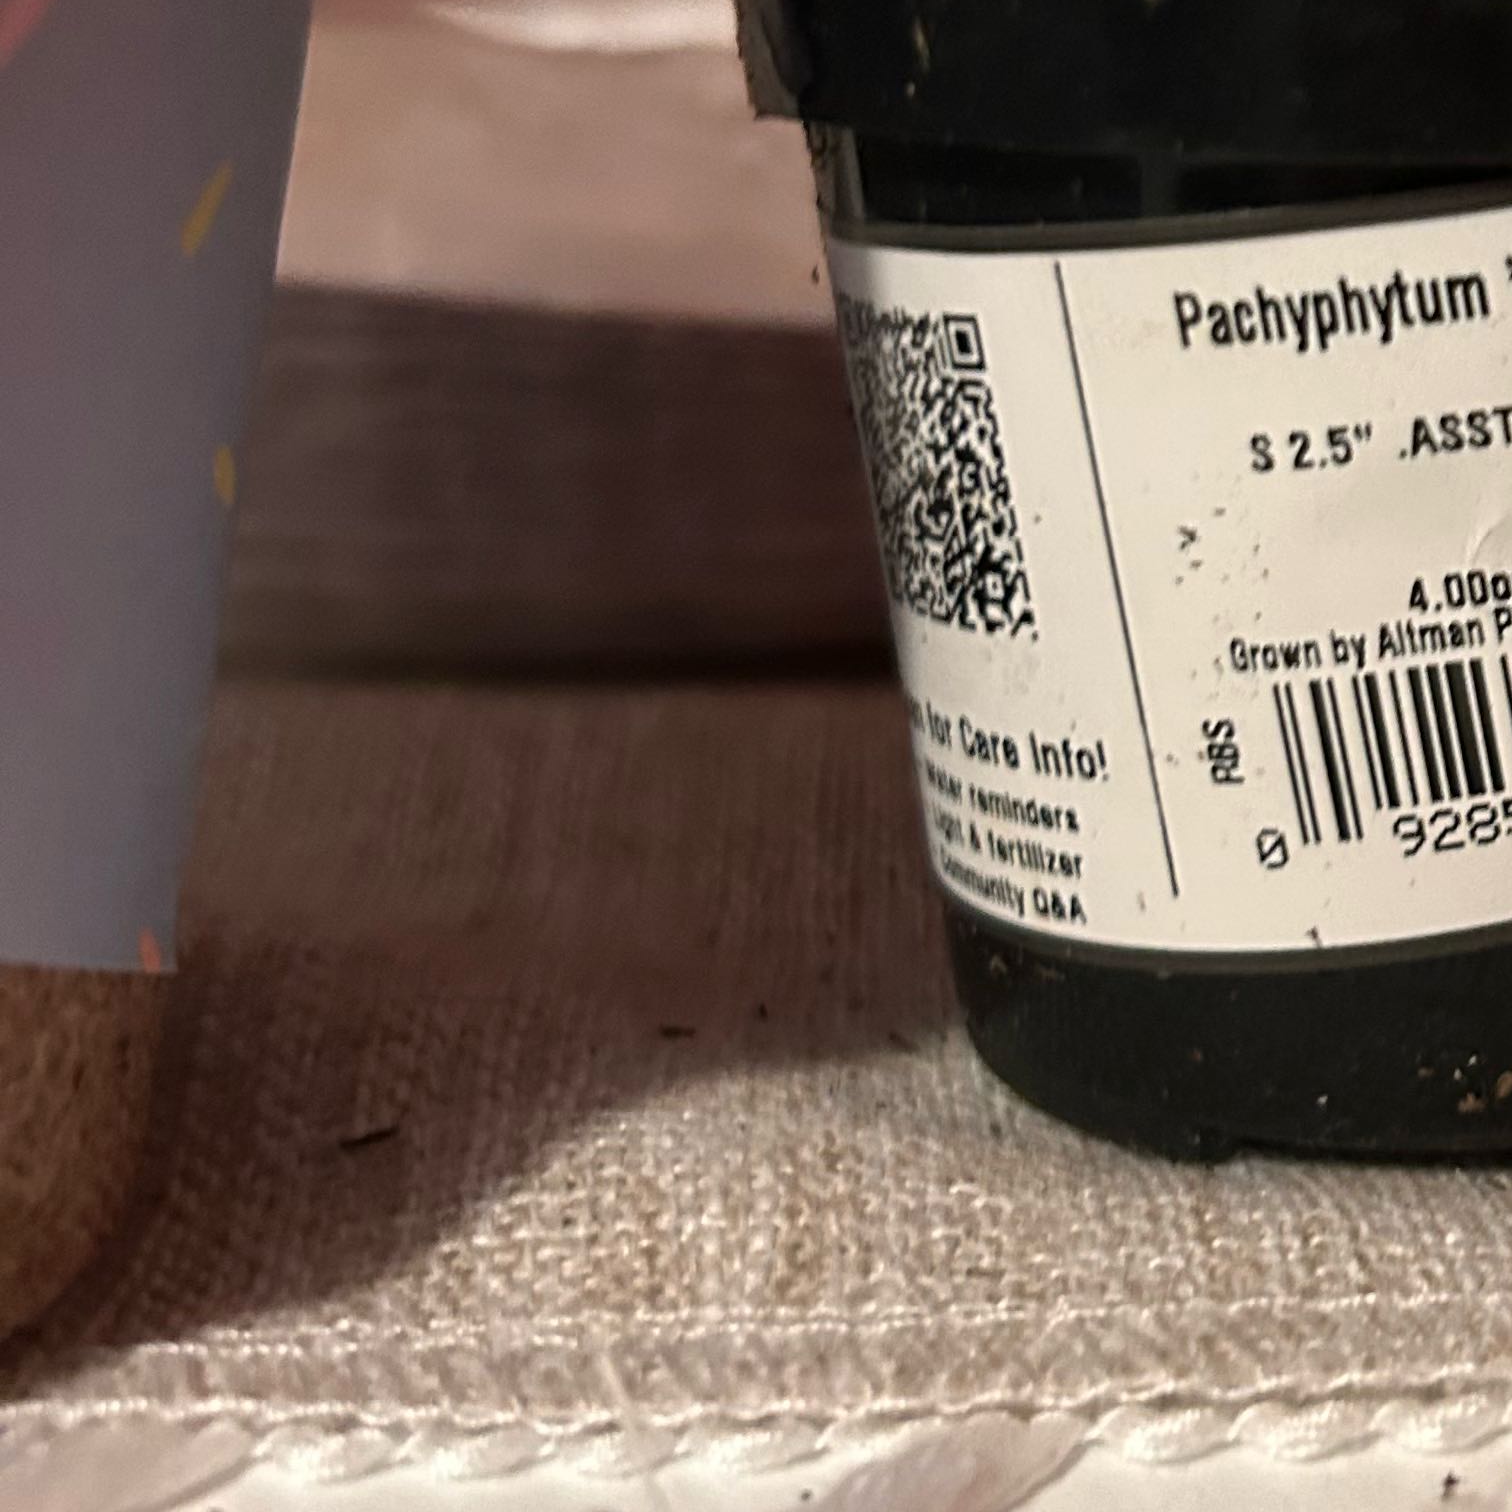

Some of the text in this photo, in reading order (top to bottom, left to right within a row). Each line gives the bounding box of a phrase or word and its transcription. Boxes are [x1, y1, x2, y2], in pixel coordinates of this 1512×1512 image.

[1173, 270, 1490, 353] Pachyphytum
[1249, 432, 1275, 473] S
[1290, 421, 1373, 471] 2.5"
[1230, 635, 1322, 672] Grown
[1330, 628, 1367, 671] by
[1378, 615, 1485, 660] Altman
[958, 713, 1020, 770] Care
[1028, 729, 1110, 783] Info!
[968, 782, 1081, 836] reminders
[986, 828, 1083, 880] fertilizer
[1256, 827, 1289, 870] 0
[1031, 885, 1088, 926] Q&A
